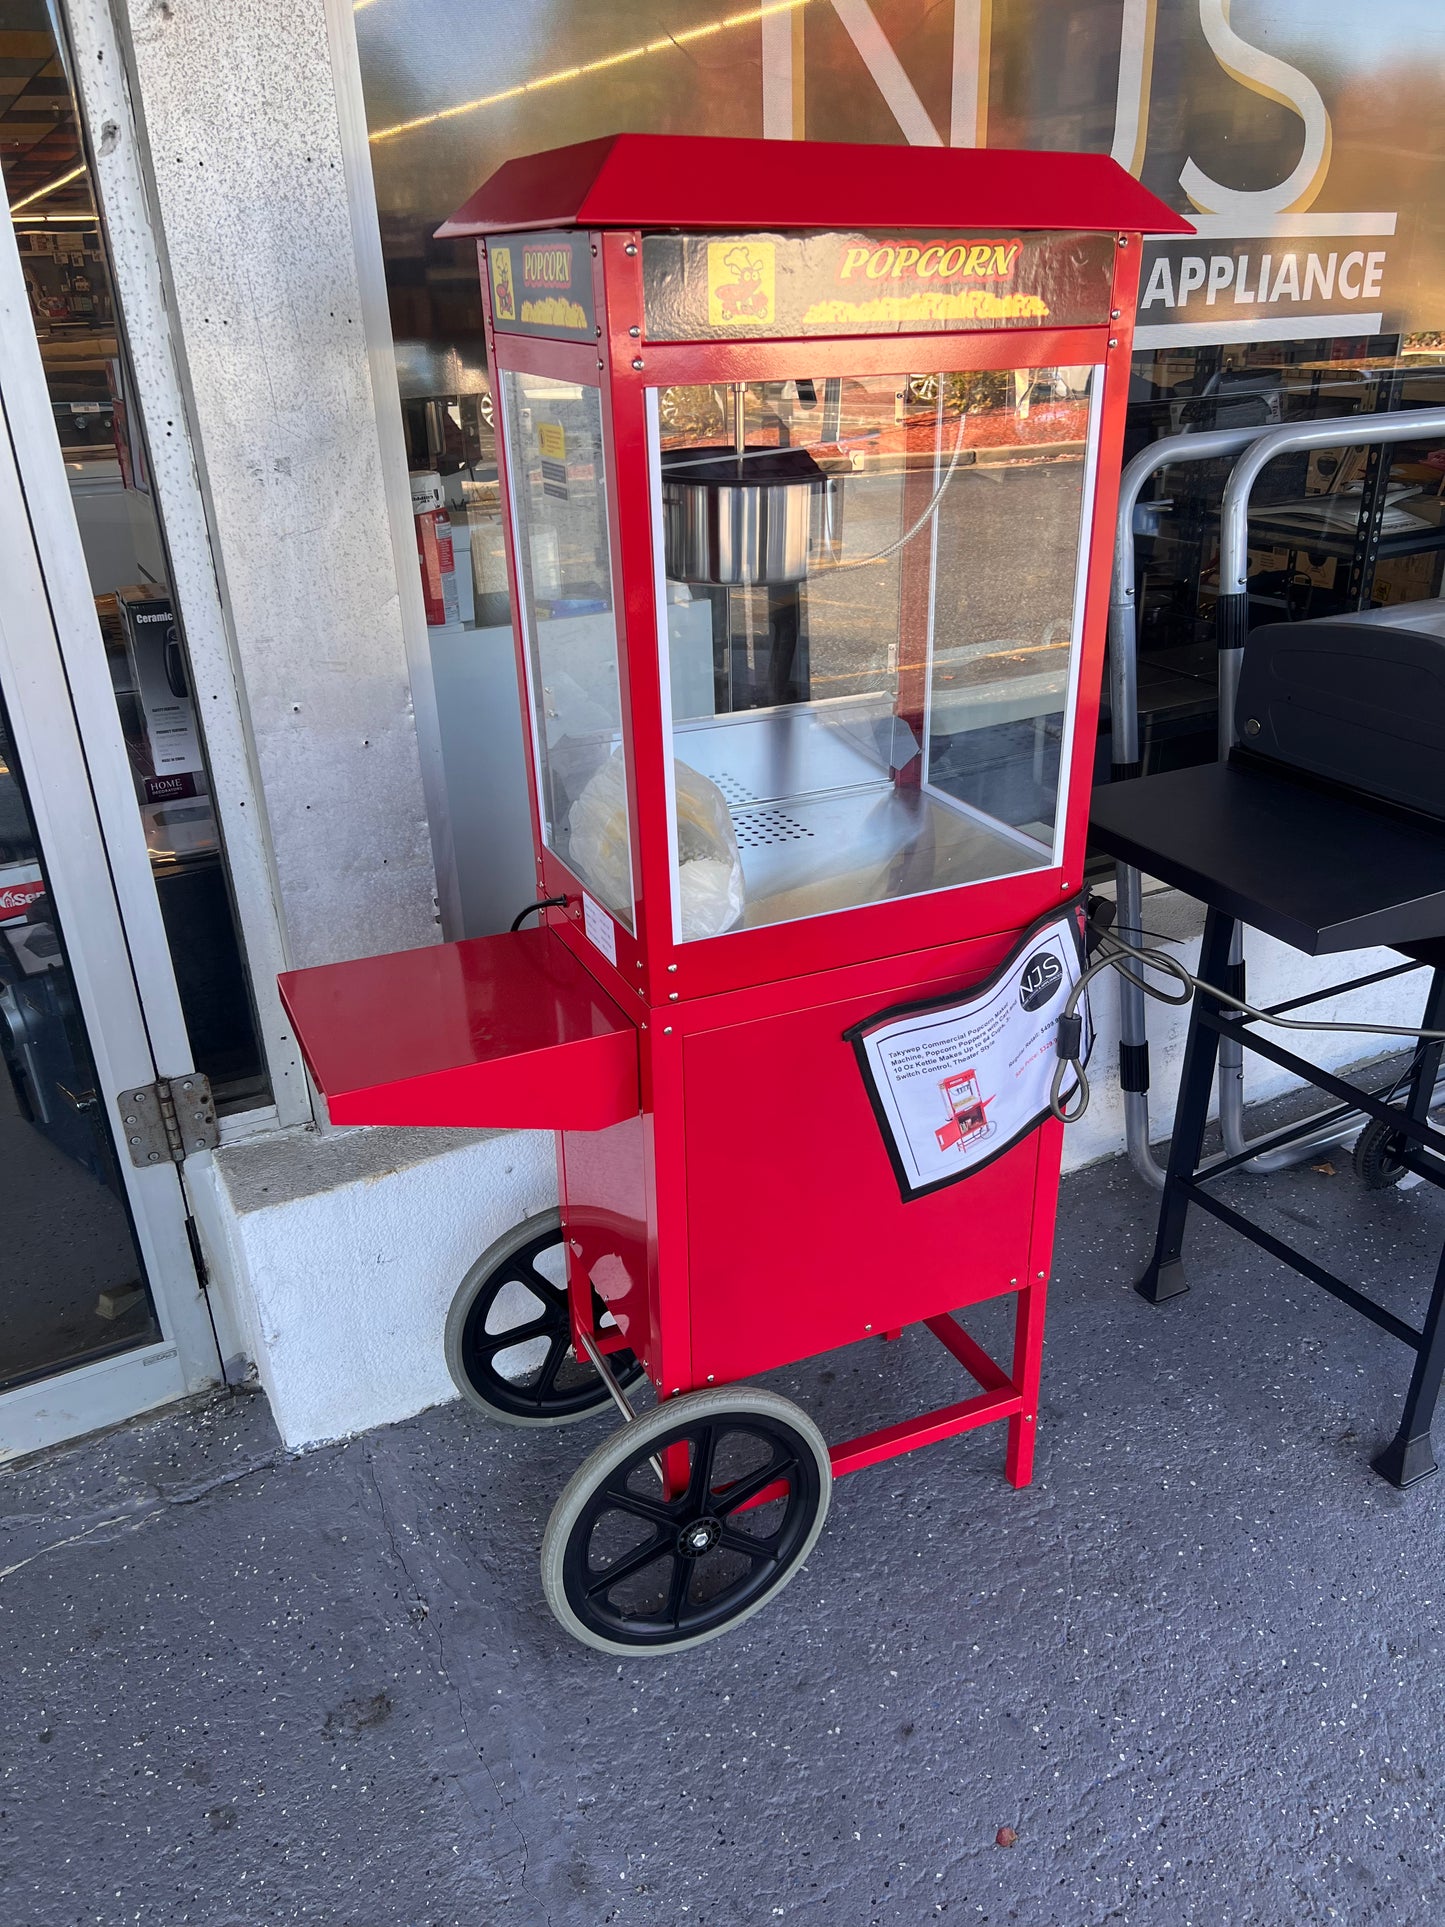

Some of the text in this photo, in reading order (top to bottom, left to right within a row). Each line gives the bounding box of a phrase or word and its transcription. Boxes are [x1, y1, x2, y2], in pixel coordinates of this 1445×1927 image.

[523, 249, 572, 283] POPCORN
[839, 244, 1020, 280] POPCORN
[1140, 251, 1386, 309] APPLIANCE
[136, 612, 173, 625] Ceramic
[150, 778, 182, 791] HOME
[1019, 956, 1059, 1003] NJS
[921, 1033, 966, 1050] Commercial
[967, 1017, 994, 1036] Popcorn
[994, 1001, 1009, 1018] Maker
[925, 1044, 957, 1057] Popcorn
[958, 1030, 987, 1048] Poppers
[893, 1066, 903, 1074] 10
[915, 1058, 938, 1068] Kettle
[938, 1051, 963, 1062] Makes
[963, 1046, 974, 1054] Up
[895, 1069, 921, 1081] Switch
[921, 1062, 952, 1074] Control,
[952, 1050, 980, 1065] Theater
